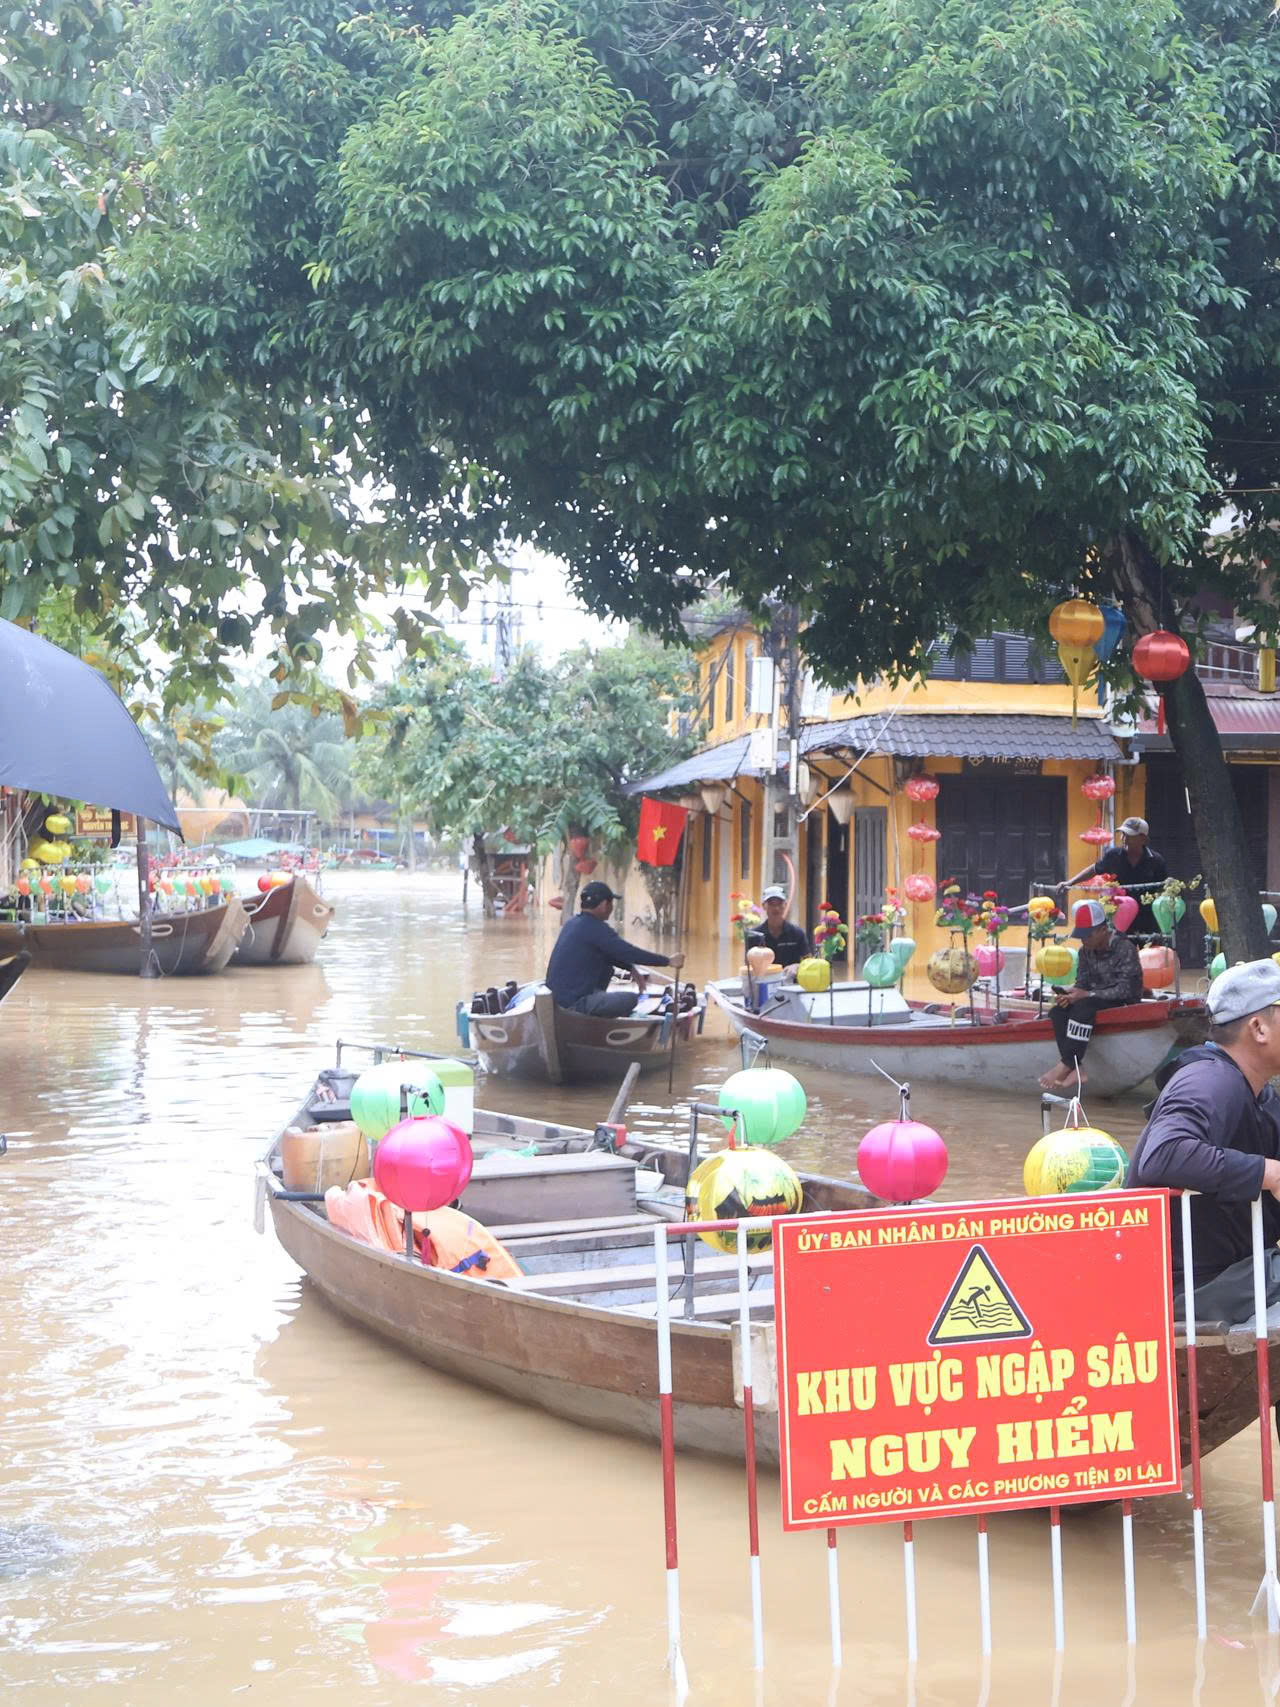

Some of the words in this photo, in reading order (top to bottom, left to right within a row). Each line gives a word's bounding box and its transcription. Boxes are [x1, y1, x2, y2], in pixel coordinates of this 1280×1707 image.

[797, 1229, 826, 1252] ỦY
[830, 1228, 872, 1249] BAN
[878, 1221, 937, 1244] NHÂN
[941, 1218, 985, 1239] DÂN
[989, 1210, 1075, 1236] PHƯỜNG
[1080, 1207, 1116, 1233] HỘI
[1122, 1208, 1149, 1226] AN
[797, 1366, 878, 1416] KHU
[888, 1349, 964, 1416] VỰC
[976, 1339, 1075, 1404] NGẬP
[1086, 1331, 1160, 1389] SÂU
[829, 1426, 977, 1481] NGUY
[996, 1395, 1135, 1464] HIỂM
[803, 1490, 848, 1514] CẤM
[853, 1486, 913, 1510] NGƯỜI
[916, 1482, 944, 1503] VÀ
[948, 1477, 989, 1498] CÁC
[994, 1472, 1070, 1495] PHƯƠNG
[1073, 1468, 1109, 1490] TIỆN
[1113, 1467, 1134, 1484] ĐI
[1137, 1463, 1163, 1484] LẠI
